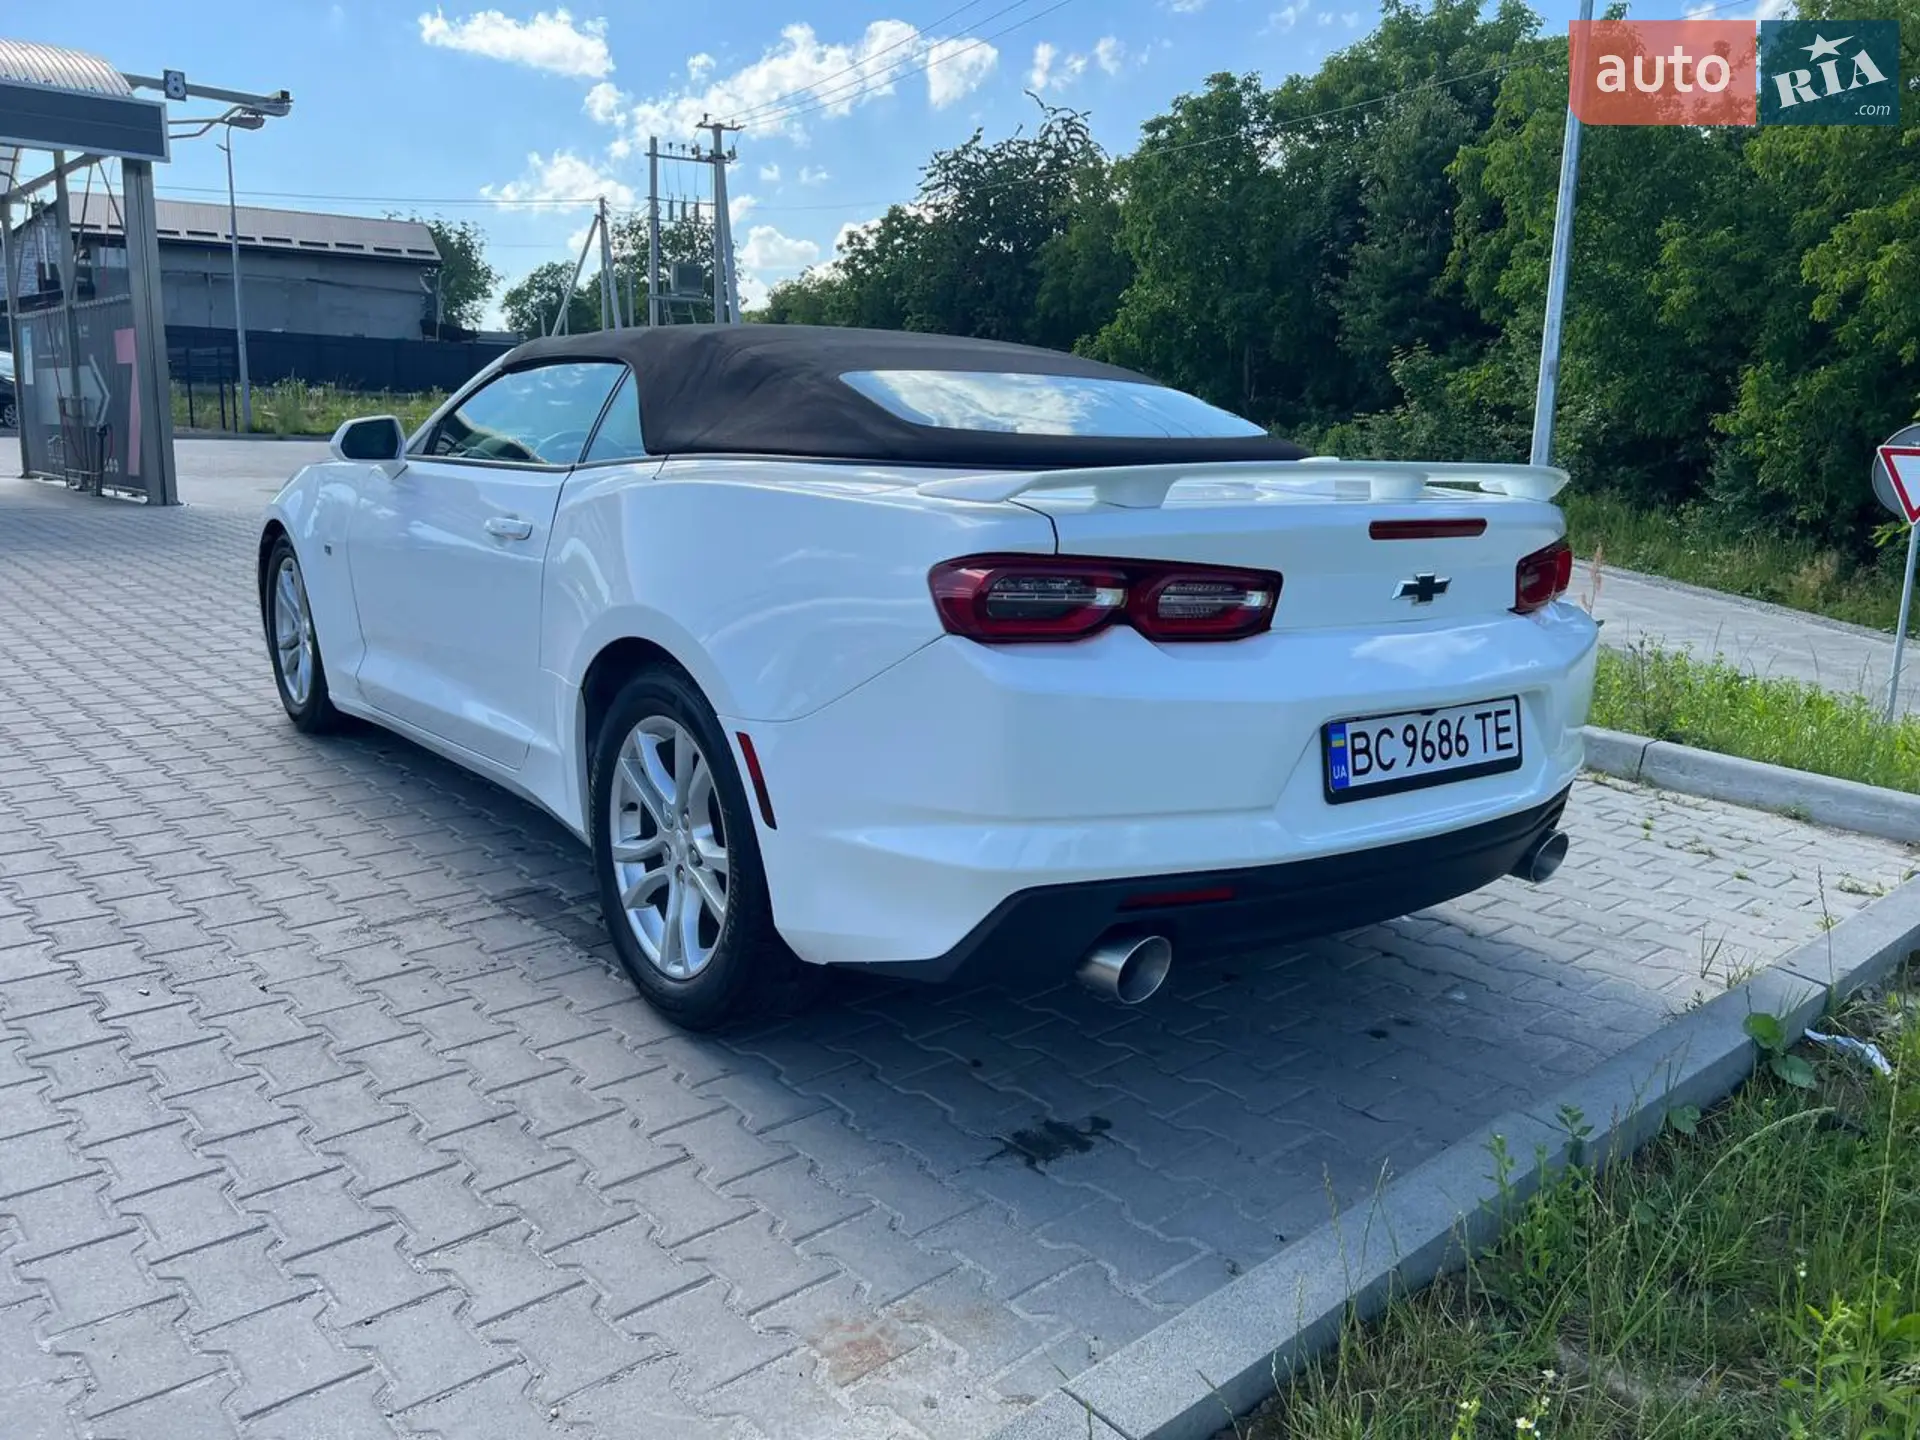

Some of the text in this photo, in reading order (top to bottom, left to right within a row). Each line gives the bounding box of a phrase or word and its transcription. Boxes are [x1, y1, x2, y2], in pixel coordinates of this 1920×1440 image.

[167, 71, 185, 98] 8
[1350, 708, 1514, 777] BC 9686 TE
[1332, 764, 1348, 780] UA
